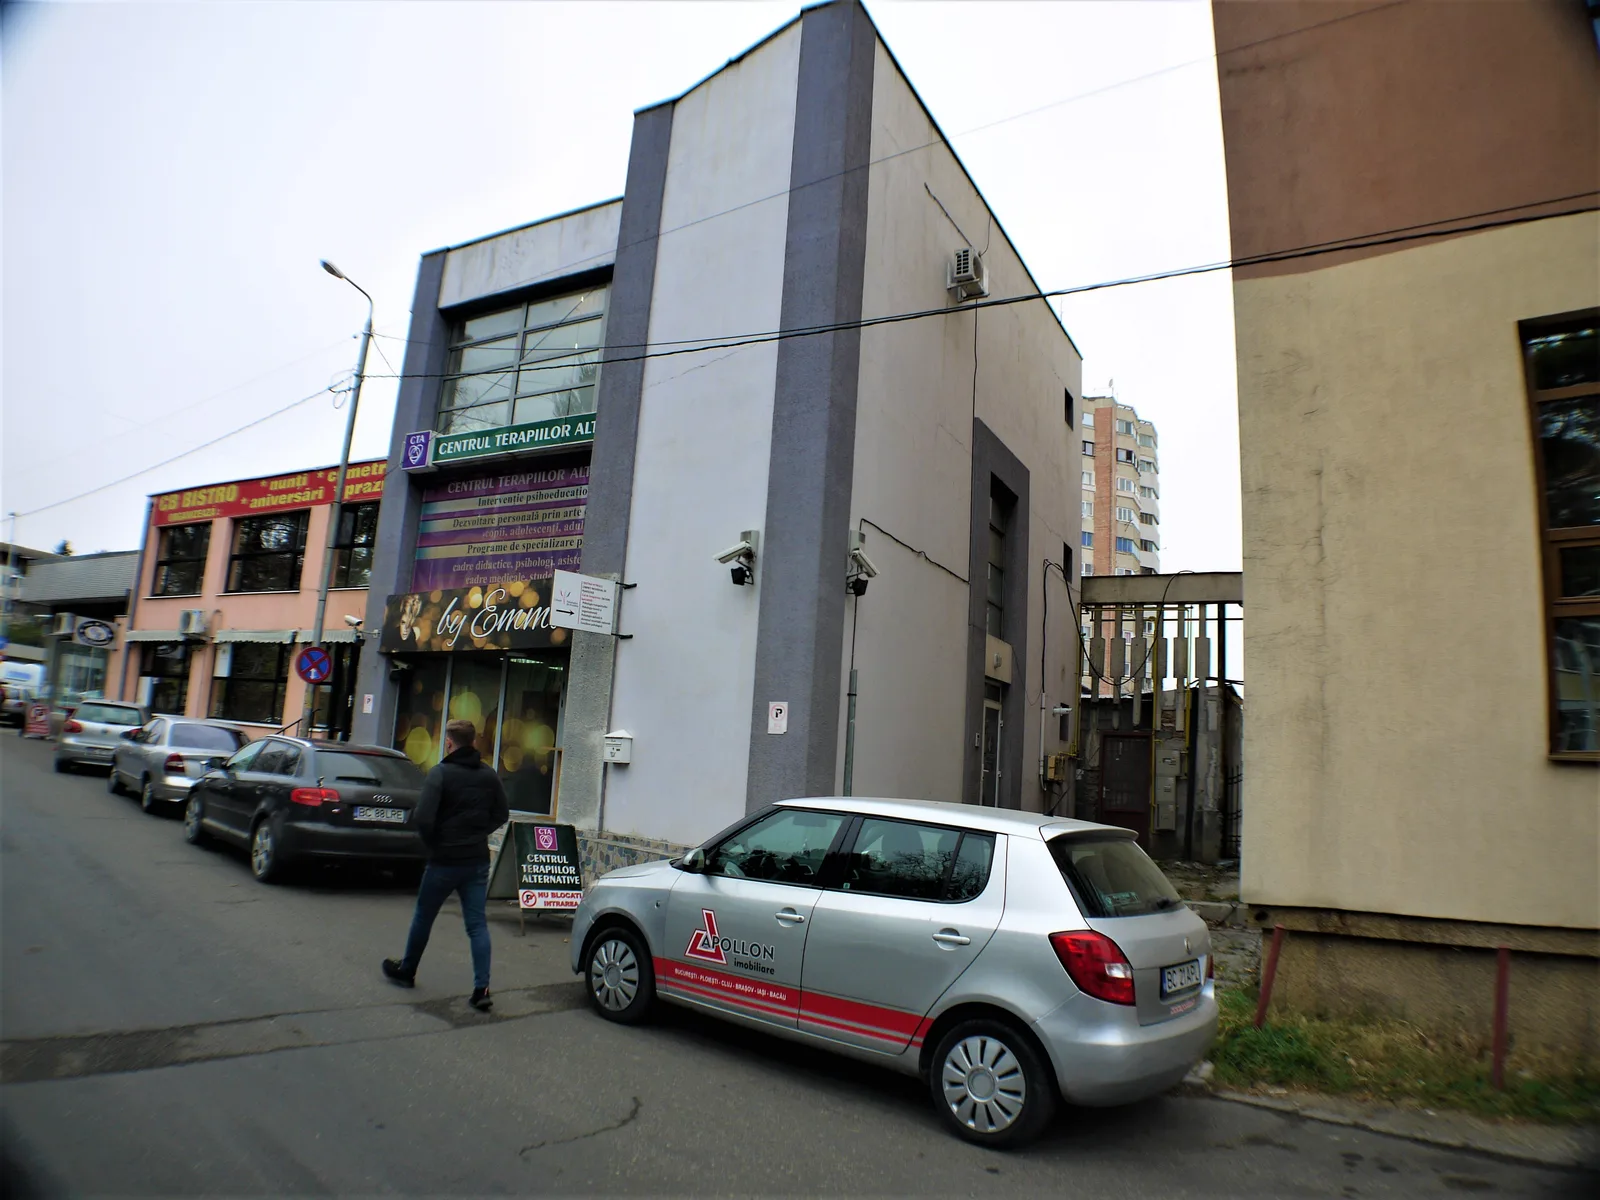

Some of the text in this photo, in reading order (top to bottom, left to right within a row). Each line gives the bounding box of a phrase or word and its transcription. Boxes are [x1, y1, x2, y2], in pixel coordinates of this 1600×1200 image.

[410, 435, 425, 444] CTA
[438, 437, 491, 455] CENTRUL
[494, 424, 570, 447] TERAPIILOR
[448, 479, 494, 494] CENTRUL
[498, 468, 565, 488] TERAPIILOR
[182, 484, 238, 508] BISTRO
[452, 516, 496, 528] Dezvoltare
[542, 510, 561, 522] prin
[563, 508, 582, 518] arte
[467, 543, 508, 555] Programe
[510, 541, 520, 551] de
[522, 538, 574, 553] specializare
[452, 562, 474, 572] cadre
[476, 560, 513, 572] didactice,
[466, 574, 488, 585] cadre
[436, 597, 467, 646] by
[526, 854, 569, 864] CENTRUL
[521, 864, 576, 874] TERAPIILOR
[522, 874, 580, 884] ALTERNATIVE
[700, 935, 775, 960] APOLLON
[734, 958, 775, 975] imobiliare
[721, 980, 733, 988] CLUJ
